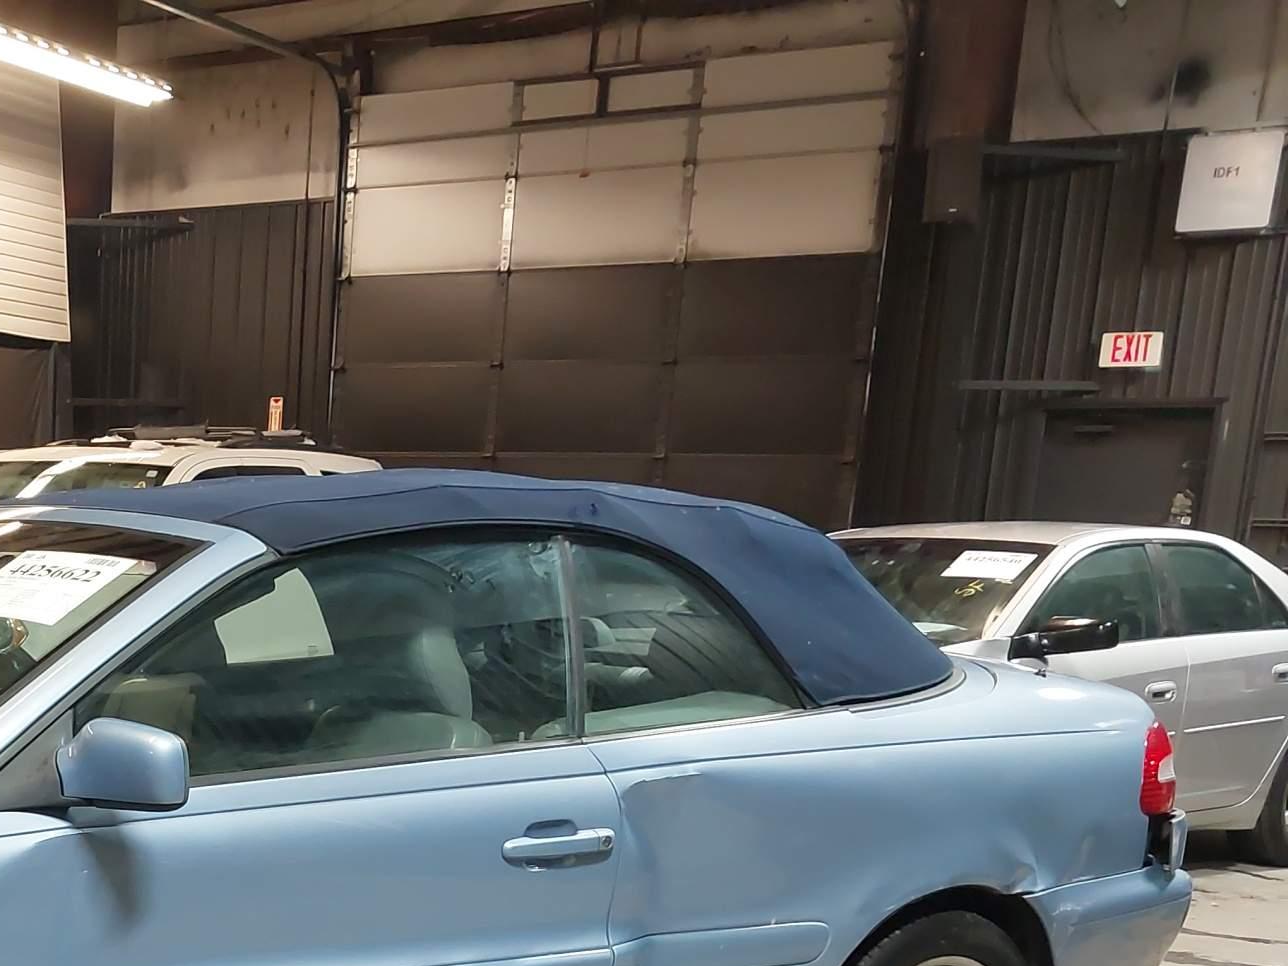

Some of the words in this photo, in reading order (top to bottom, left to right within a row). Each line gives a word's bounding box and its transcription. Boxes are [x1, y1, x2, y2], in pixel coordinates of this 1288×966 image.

[1213, 166, 1240, 178] IDF1
[1111, 334, 1153, 362] EXIT
[9, 563, 102, 583] 44256622
